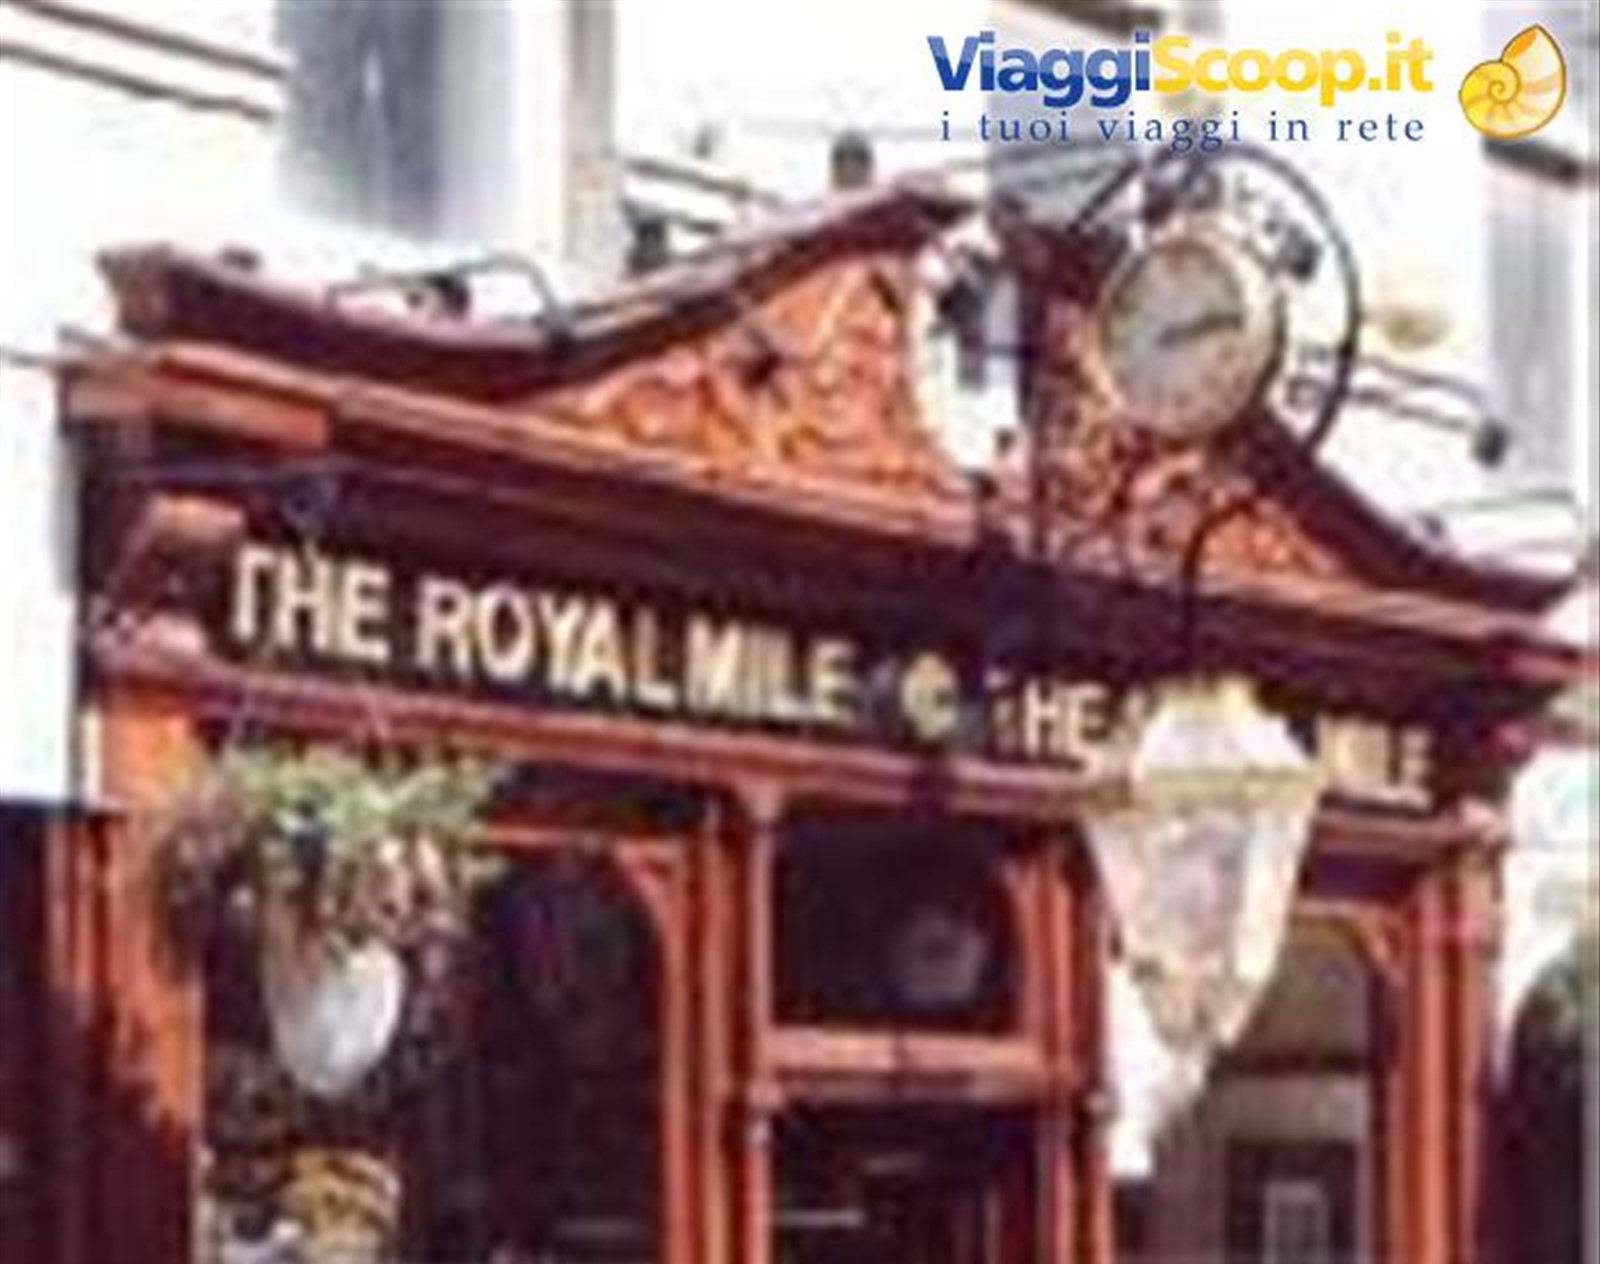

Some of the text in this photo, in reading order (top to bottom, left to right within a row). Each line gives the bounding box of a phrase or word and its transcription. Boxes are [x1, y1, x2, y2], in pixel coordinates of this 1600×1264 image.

[232, 546, 856, 722] THE ROYAL MILE
